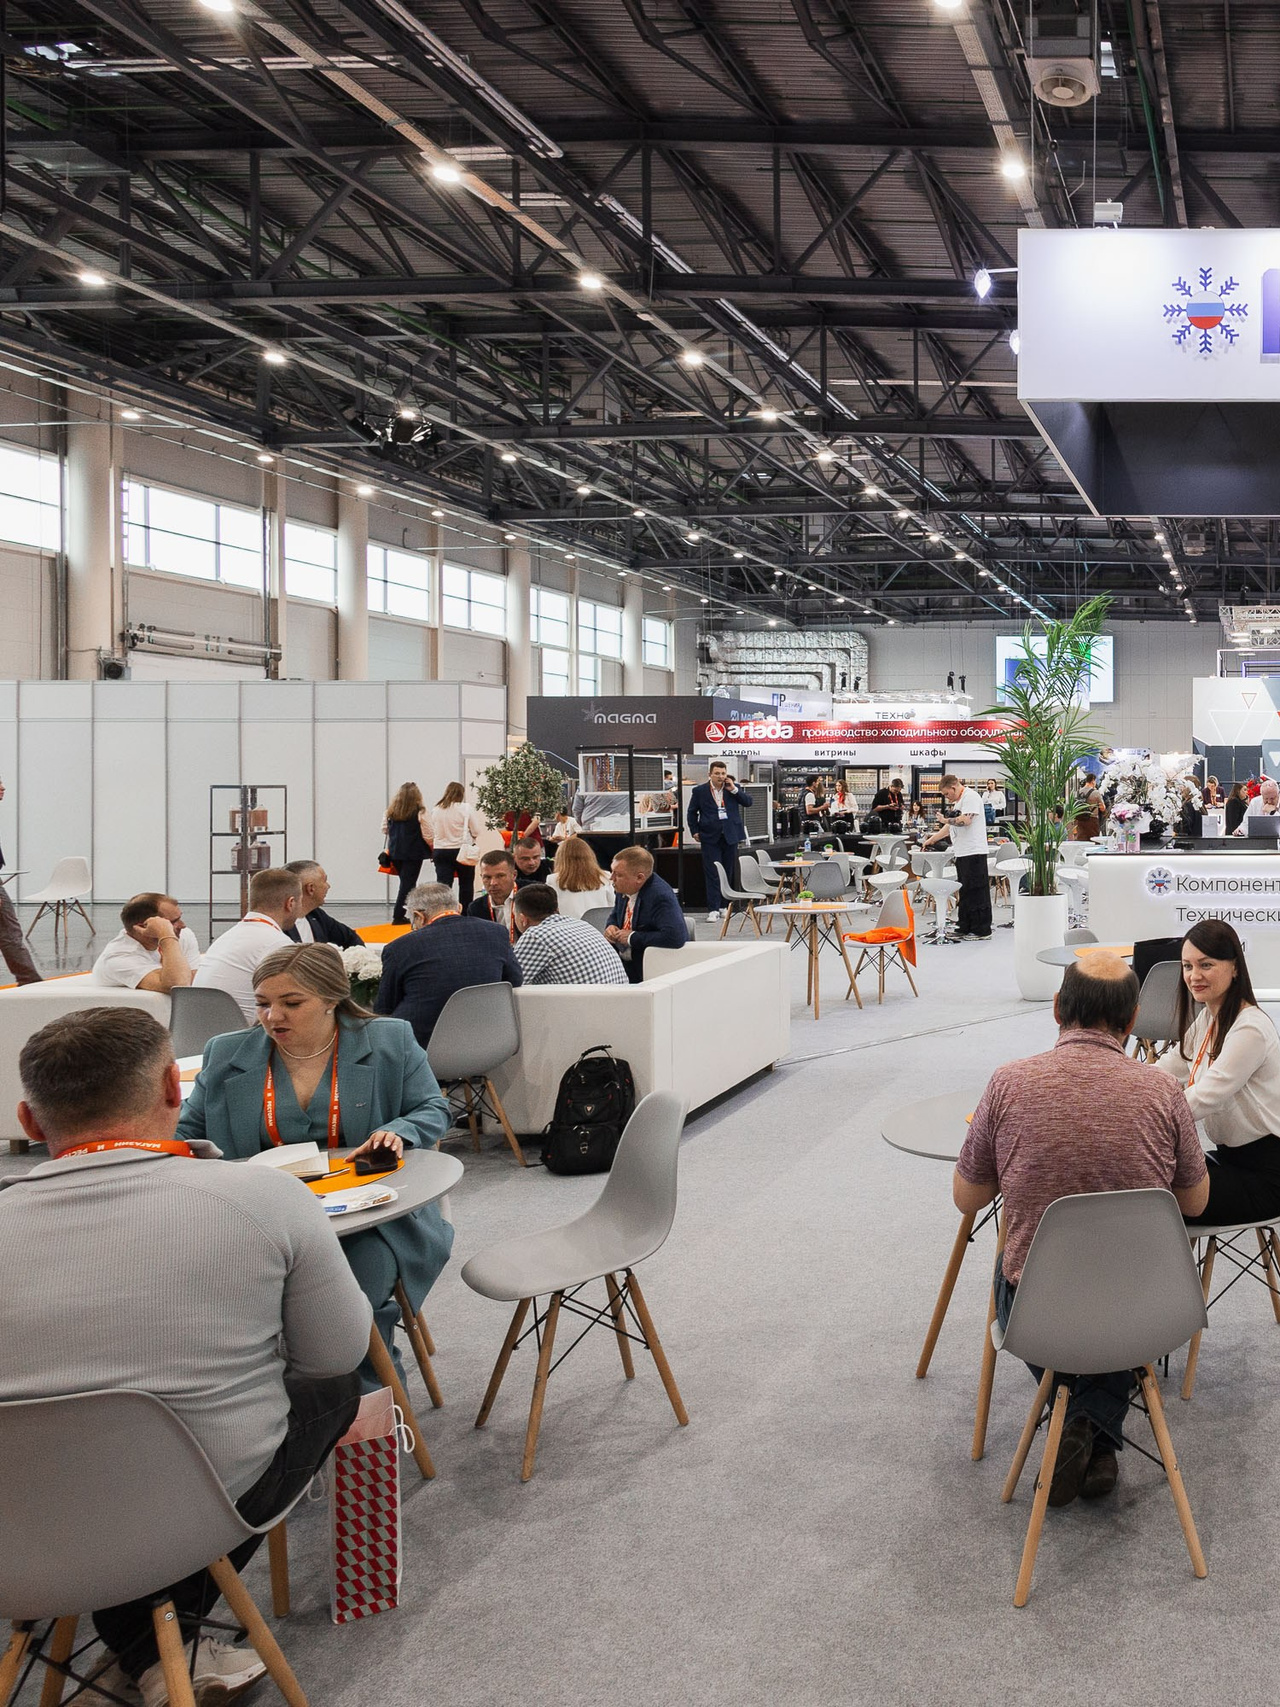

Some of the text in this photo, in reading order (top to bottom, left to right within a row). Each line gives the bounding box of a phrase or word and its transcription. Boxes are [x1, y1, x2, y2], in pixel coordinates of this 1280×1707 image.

[727, 721, 794, 739] ariada
[802, 727, 878, 738] производство
[880, 727, 959, 738] холодильного
[814, 749, 857, 758] витрины
[909, 749, 947, 758] шкафы
